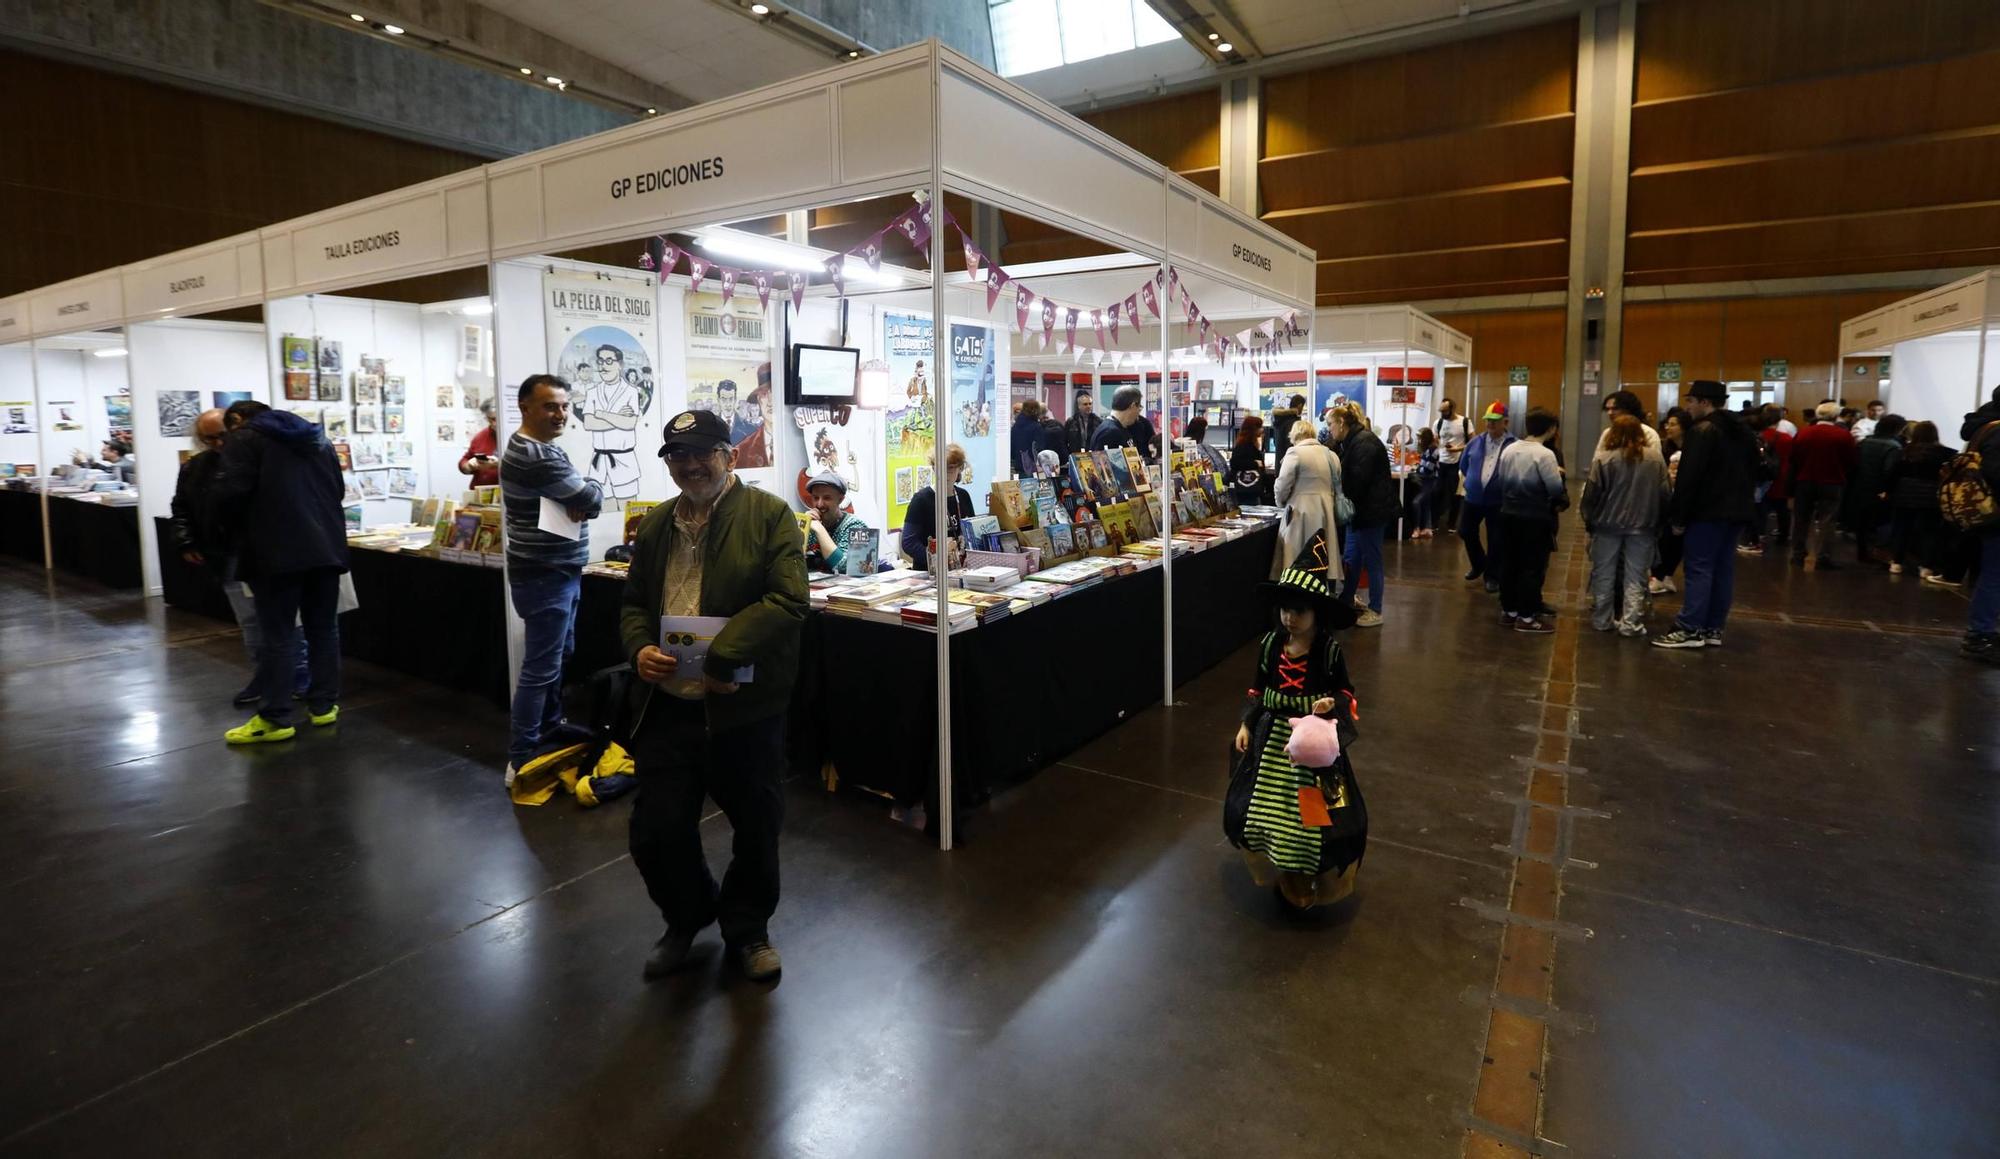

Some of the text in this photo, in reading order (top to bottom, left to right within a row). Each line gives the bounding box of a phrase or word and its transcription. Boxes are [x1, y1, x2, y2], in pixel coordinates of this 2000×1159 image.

[611, 156, 724, 199] GP EDICIONES
[324, 230, 400, 260] TAULA EDICIONES
[1232, 243, 1272, 272] GP EDICIONES
[552, 290, 651, 316] LA PELEA DEL SIGLO
[694, 315, 763, 339] PLOMO GUALDA
[954, 336, 985, 356] GATOS
